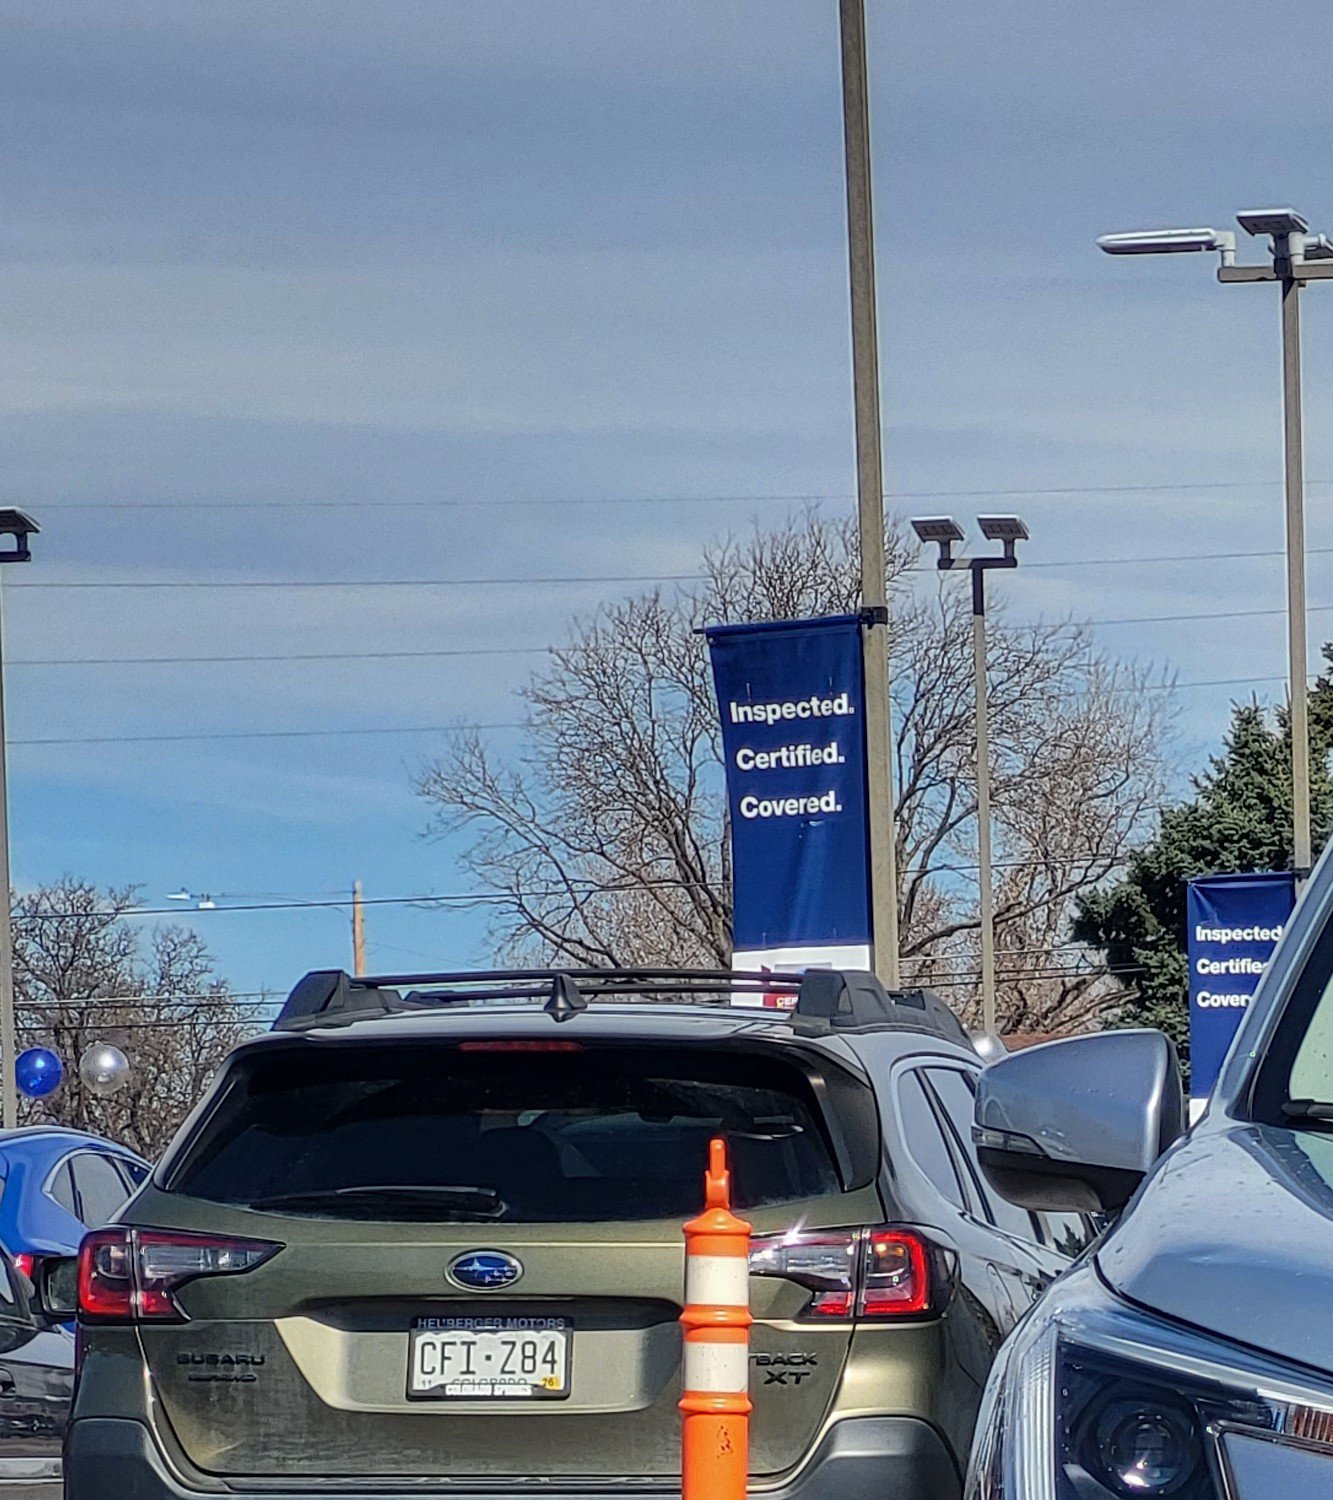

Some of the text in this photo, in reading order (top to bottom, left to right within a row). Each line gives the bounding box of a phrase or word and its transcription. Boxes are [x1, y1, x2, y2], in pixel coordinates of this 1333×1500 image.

[730, 693, 855, 725] Inspected.
[736, 742, 845, 770] Certified.
[740, 790, 842, 818] Covered.
[1197, 991, 1252, 1007] Cover
[506, 1317, 565, 1330] MOTORS
[763, 1370, 810, 1385] XT
